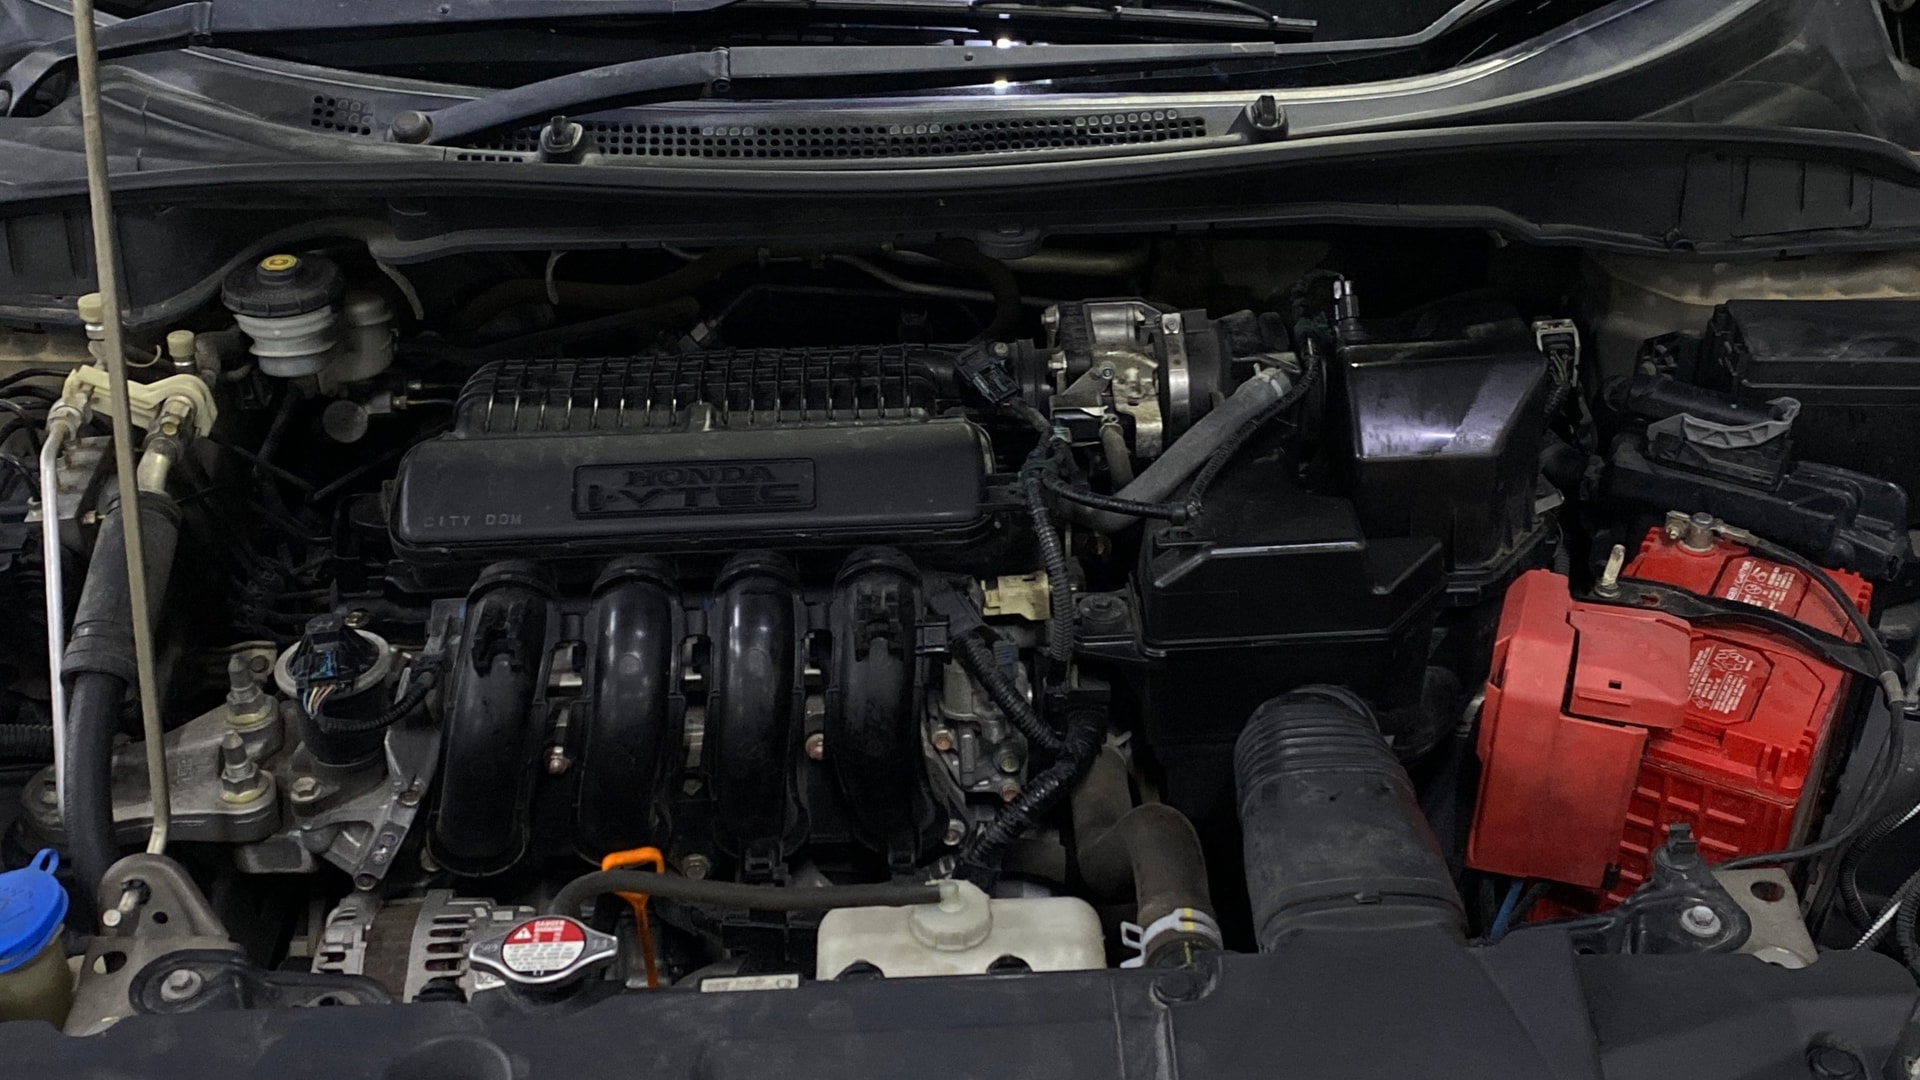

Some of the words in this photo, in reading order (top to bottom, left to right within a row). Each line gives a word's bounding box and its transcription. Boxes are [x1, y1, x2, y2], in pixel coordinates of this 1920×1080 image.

[625, 466, 777, 487] HONDA
[423, 515, 471, 528] CITY
[485, 513, 522, 526] DOM
